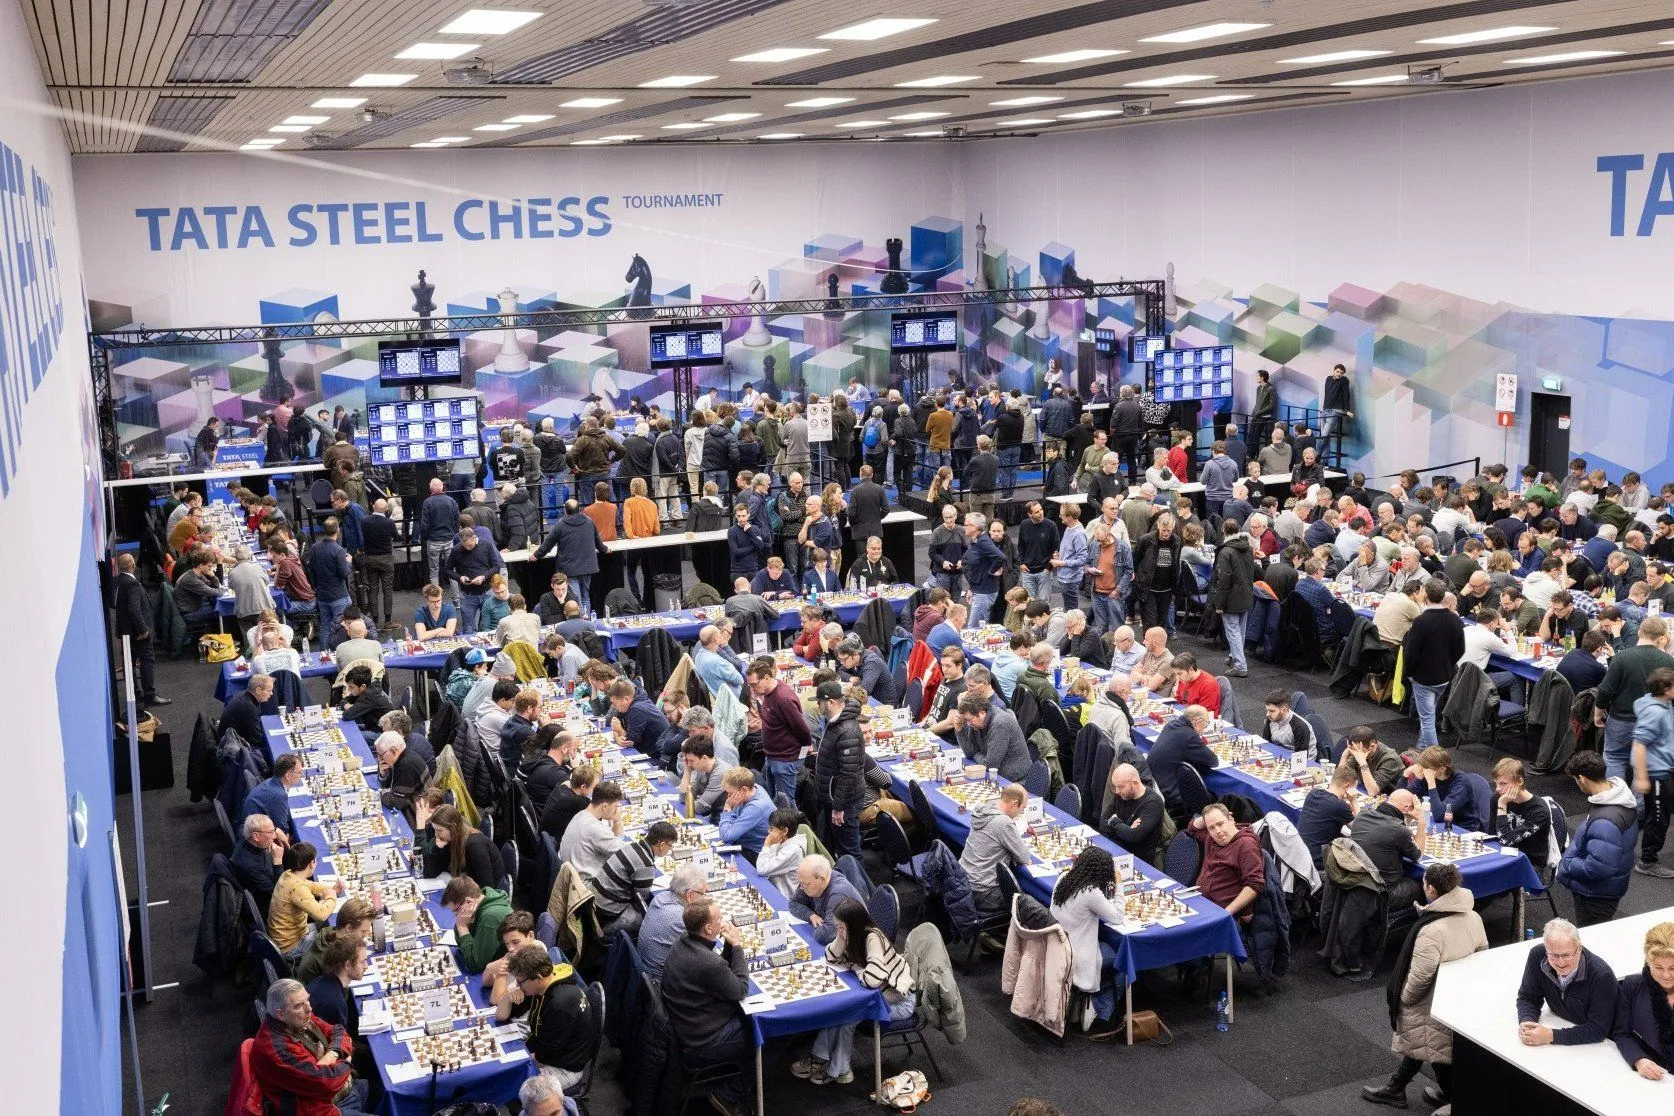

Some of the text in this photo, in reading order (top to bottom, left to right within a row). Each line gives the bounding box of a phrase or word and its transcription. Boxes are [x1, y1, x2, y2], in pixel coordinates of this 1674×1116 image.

[623, 193, 724, 209] TOURNAMENT
[136, 196, 612, 251] TATA STEEL CHESS
